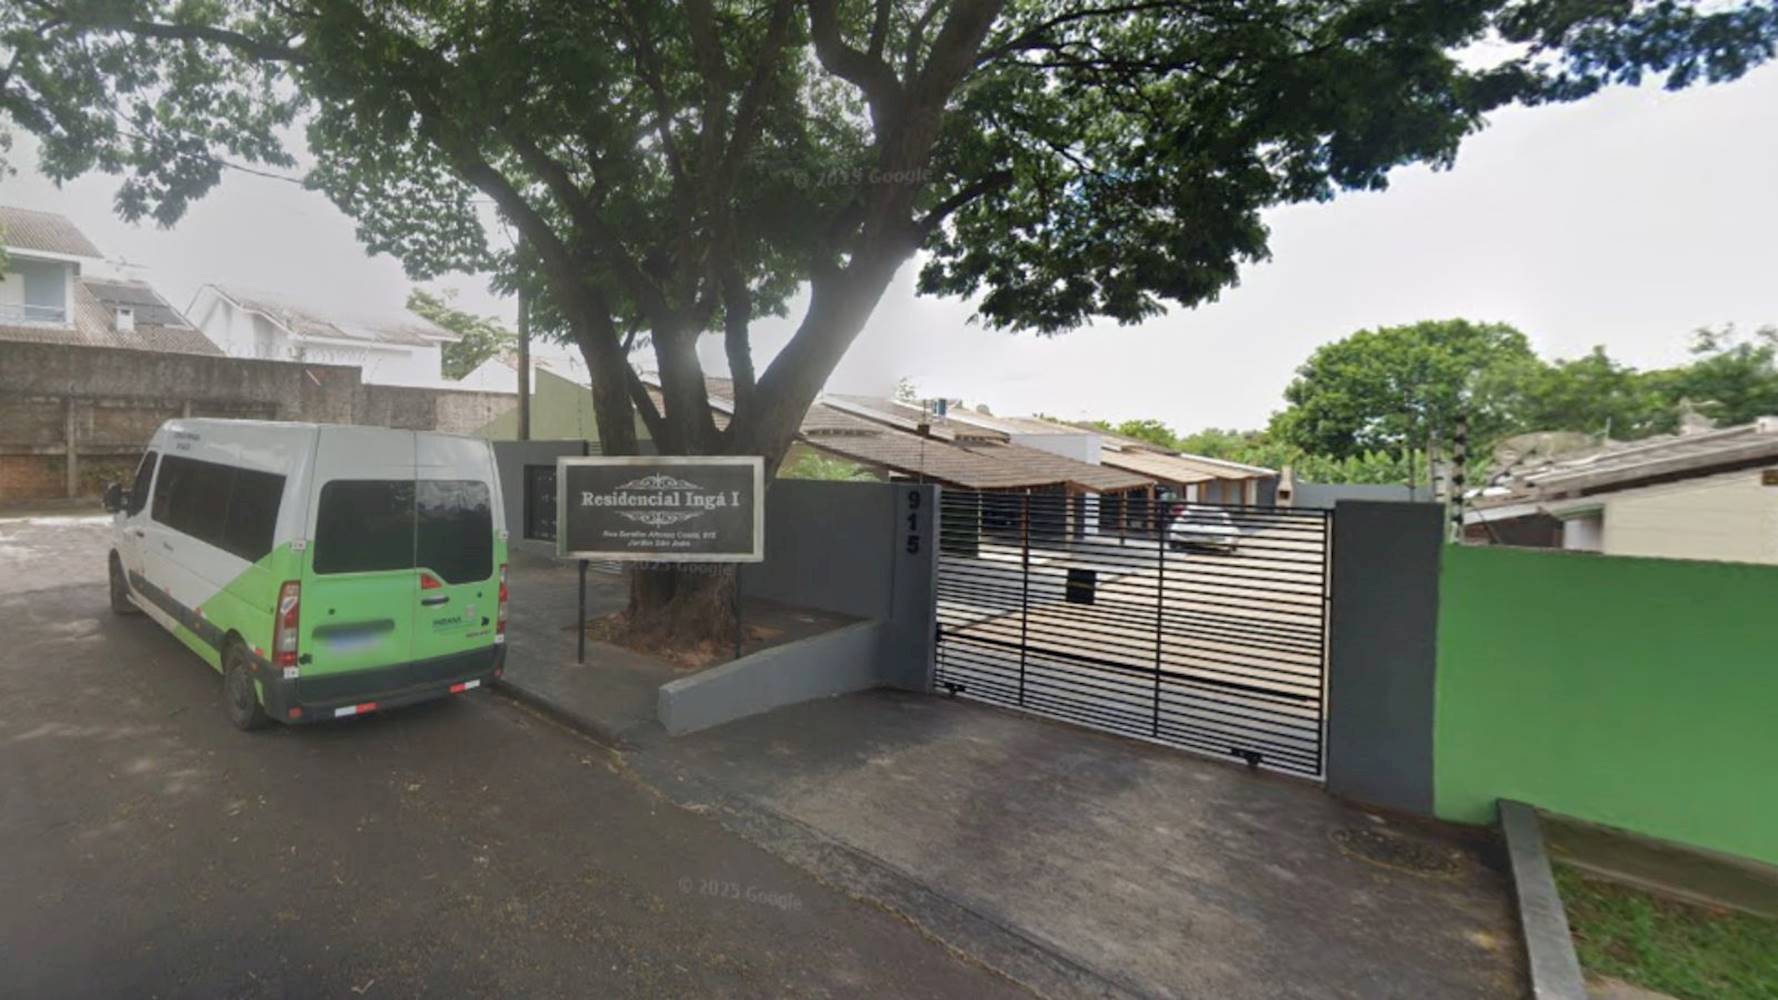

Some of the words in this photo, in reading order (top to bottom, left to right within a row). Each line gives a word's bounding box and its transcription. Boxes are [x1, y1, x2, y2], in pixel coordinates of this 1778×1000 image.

[581, 491, 680, 507] Residencial
[685, 490, 726, 510] Ingá
[732, 491, 740, 507] I
[906, 490, 921, 555] 915
